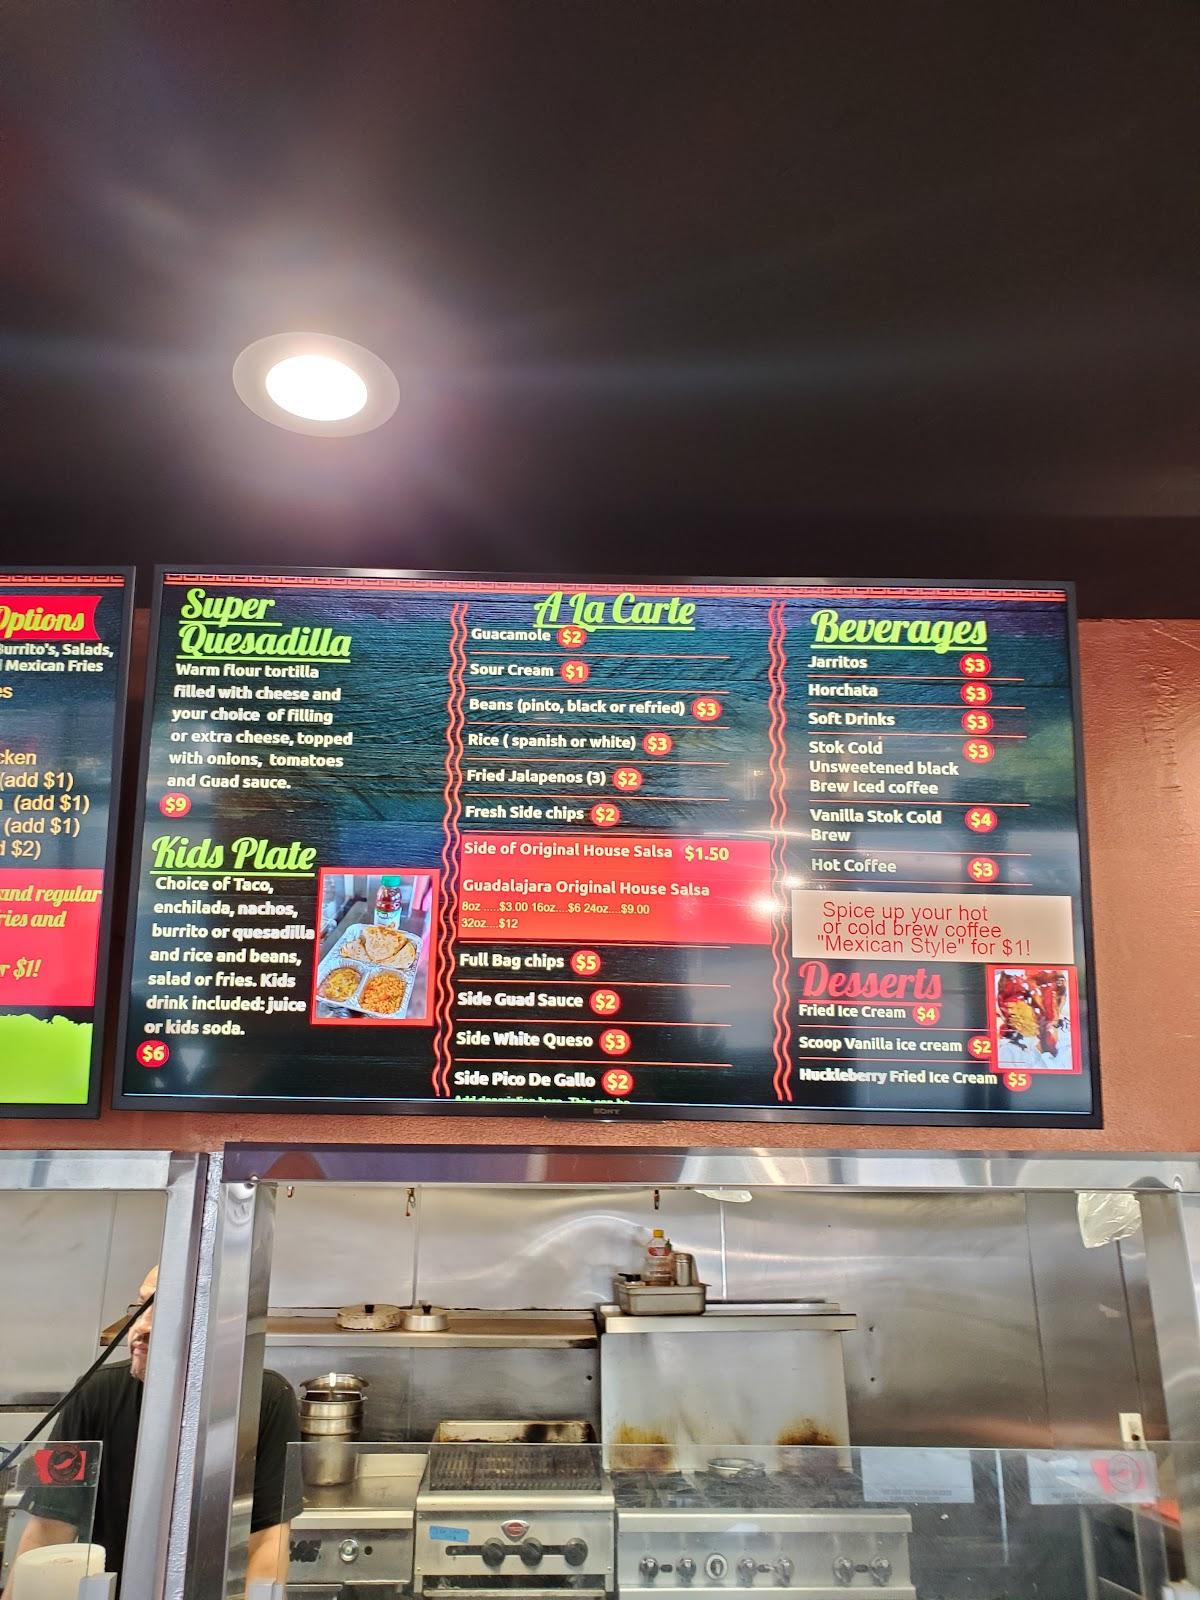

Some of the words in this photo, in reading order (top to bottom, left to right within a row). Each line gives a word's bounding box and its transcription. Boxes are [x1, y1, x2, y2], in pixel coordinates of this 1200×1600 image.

[181, 588, 275, 628] Super
[533, 591, 563, 626] A
[568, 592, 604, 632] La
[612, 592, 696, 625] Carte
[179, 623, 352, 657] Quesadilla
[471, 628, 551, 642] Guacamole
[562, 630, 582, 645] $2
[810, 609, 988, 654] Beverages
[5, 660, 65, 672] Mexican
[67, 660, 104, 672] Fries
[176, 663, 220, 676] Warm
[223, 664, 261, 677] flour
[264, 665, 320, 678] tortilla
[470, 664, 505, 676] Sour
[507, 664, 554, 677] Cream
[565, 665, 585, 680] $1
[807, 655, 868, 668] Jarritos
[965, 657, 986, 673] $3
[173, 685, 215, 699] filled
[218, 686, 253, 700] with
[255, 686, 309, 700] cheese
[312, 688, 342, 701] and
[808, 683, 878, 697] Horchata
[966, 686, 986, 702] $3
[171, 708, 208, 723] your
[210, 707, 261, 722] choice
[267, 708, 285, 722] of
[287, 708, 334, 725] filling
[469, 698, 513, 711] Beans
[517, 699, 564, 714] (pinto,
[567, 699, 606, 713] black
[609, 703, 626, 713] or
[629, 700, 685, 716] refried)
[697, 702, 717, 717] $3
[808, 712, 842, 725] Soft
[845, 713, 895, 726] Drinks
[967, 714, 988, 730] $3
[170, 732, 188, 742] or
[191, 732, 232, 743] extra
[235, 730, 294, 746] cheese,
[297, 732, 353, 747] topped
[468, 734, 499, 746] Rice
[511, 735, 567, 750] spanish
[570, 738, 586, 748] or
[589, 735, 637, 751] white)
[647, 736, 667, 752] $3
[809, 741, 844, 754] Stok
[848, 741, 883, 754] Cold
[968, 743, 989, 760] $3
[809, 760, 914, 775] Unsweetened
[917, 761, 959, 776] black
[167, 774, 196, 787] and
[200, 775, 240, 788] Guad
[242, 778, 292, 789] sauce.
[467, 769, 505, 782] Fried
[508, 770, 583, 784] Jalapenos
[586, 771, 607, 787] (3)
[617, 771, 638, 787] $2
[809, 780, 849, 793] Brew
[853, 780, 885, 793] Iced
[888, 780, 938, 794] coffee
[14, 795, 55, 814] (add
[60, 794, 90, 814] $1)
[165, 797, 187, 813] $9
[465, 806, 507, 818] Fresh
[510, 806, 542, 819] Side
[546, 807, 585, 822] chips
[595, 807, 615, 823] $2
[809, 808, 864, 823] Vanilla
[867, 809, 903, 824] Stok
[906, 810, 943, 824] Cold
[971, 812, 992, 828] $4
[4, 818, 45, 837] (add
[50, 817, 80, 837] $1)
[152, 836, 224, 869] Kids
[231, 837, 317, 870] Plate
[464, 842, 496, 855] Side
[499, 842, 517, 855] of
[520, 842, 580, 858] Original
[583, 844, 630, 857] House
[633, 845, 673, 858] Salsa
[684, 847, 729, 862] $1.50
[811, 858, 841, 872] Hot
[844, 858, 897, 873] Coffee
[972, 862, 994, 878] $3
[155, 876, 209, 891] Choice
[212, 877, 231, 891] of
[233, 878, 274, 894] Taco,
[463, 879, 552, 894] Guadalajara
[556, 880, 616, 896] Original
[620, 882, 667, 895] House
[670, 883, 710, 896] Salsa
[153, 900, 235, 917] enchilada,
[237, 901, 298, 918] nachos,
[823, 901, 875, 921] Spice
[881, 906, 905, 922] up
[912, 905, 953, 923] your
[958, 904, 988, 921] hot
[152, 923, 209, 938] burrito
[211, 928, 230, 939] or
[232, 925, 315, 941] quesadilla
[823, 921, 842, 935] or
[847, 919, 886, 936] cold
[893, 921, 938, 937] brew
[945, 922, 1002, 938] coffee
[817, 935, 904, 953] "Mexican
[910, 937, 965, 958] Style"
[971, 938, 996, 955] for
[1002, 938, 1031, 957] $1!
[150, 947, 180, 962] and
[183, 948, 213, 962] rice
[216, 949, 246, 963] and
[249, 949, 302, 966] beans,
[460, 953, 489, 967] Full
[492, 953, 521, 970] Bag
[524, 954, 564, 970] chips
[575, 955, 597, 971] $5
[147, 971, 191, 986] salad
[194, 975, 212, 987] or
[215, 972, 257, 987] fries.
[260, 973, 296, 988] Kids
[800, 960, 942, 999] Desserts
[146, 995, 189, 1010] drink
[191, 995, 265, 1011] included:
[265, 997, 307, 1014] juice
[457, 992, 492, 1006] Side
[495, 992, 535, 1007] Guad
[537, 993, 583, 1008] Sauce
[595, 995, 616, 1011] $2
[799, 1004, 835, 1017] Fried
[838, 1004, 858, 1018] Ice
[862, 1005, 906, 1019] Cream
[917, 1007, 936, 1022] $4
[142, 1045, 165, 1063] $6
[799, 1036, 842, 1052] Scoop
[844, 1037, 893, 1051] Vanilla
[896, 1037, 917, 1051] ice
[919, 1041, 963, 1052] cream
[973, 1039, 991, 1055] $2
[454, 1071, 489, 1086] Side
[491, 1071, 525, 1086] Pico
[528, 1072, 551, 1086] De
[554, 1073, 596, 1088] Gallo
[607, 1074, 629, 1091] $2
[799, 1068, 887, 1084] Huckleberry
[890, 1070, 926, 1083] Fried
[929, 1071, 949, 1084] Ice
[952, 1071, 998, 1085] Cream
[1008, 1073, 1028, 1088] $5
